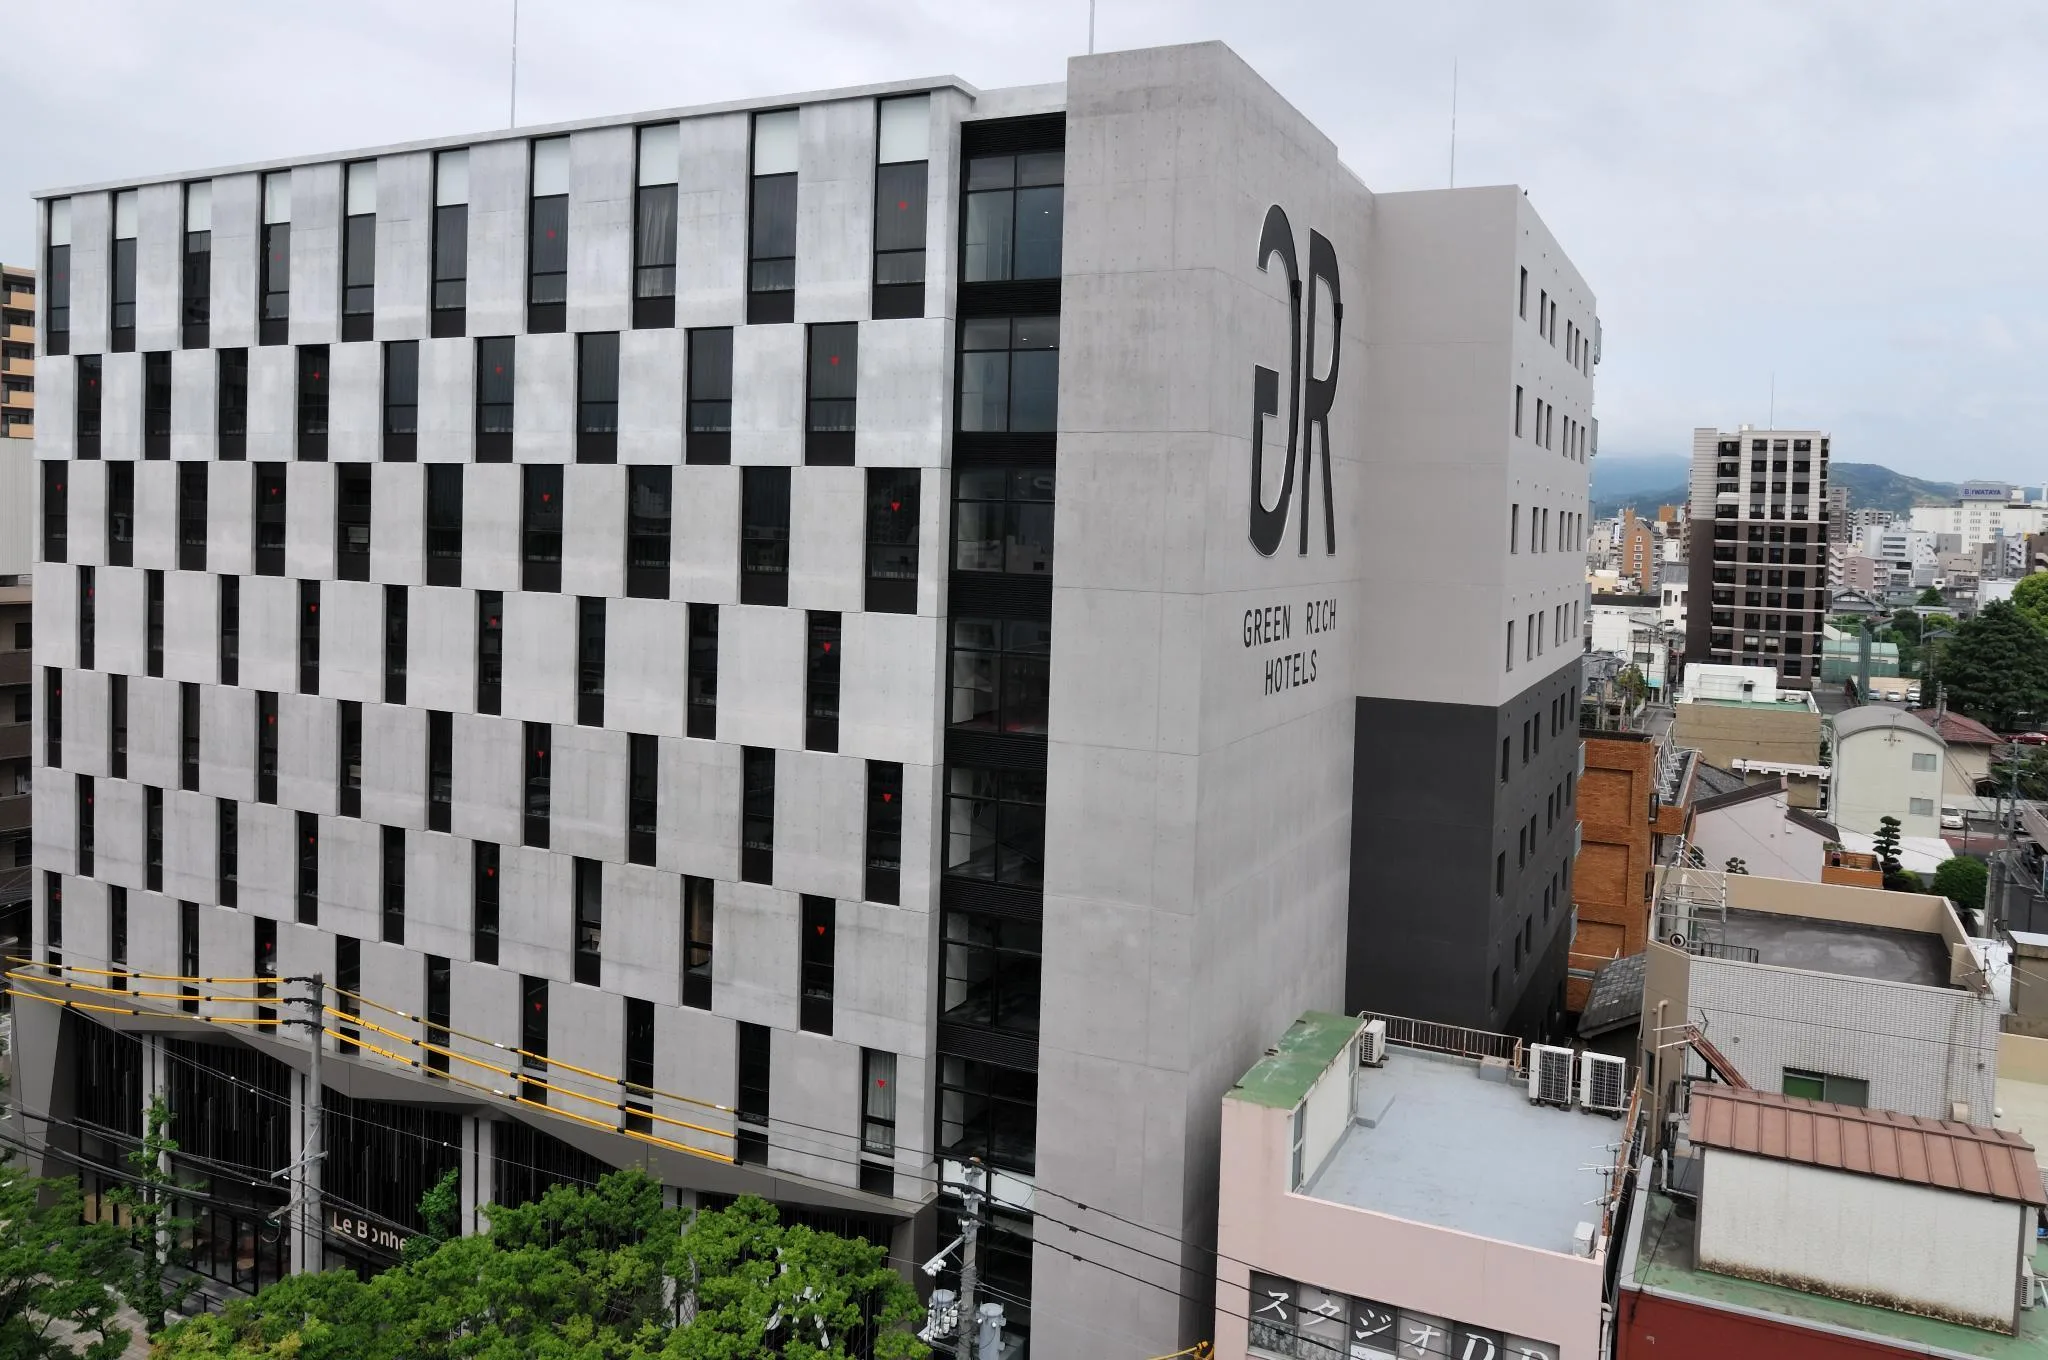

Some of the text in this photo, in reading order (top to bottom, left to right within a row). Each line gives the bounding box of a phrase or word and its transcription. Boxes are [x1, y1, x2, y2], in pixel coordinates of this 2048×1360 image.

[1243, 598, 1337, 648] GREEN RICH
[1265, 649, 1317, 696] HOTELS
[333, 1211, 353, 1234] Le
